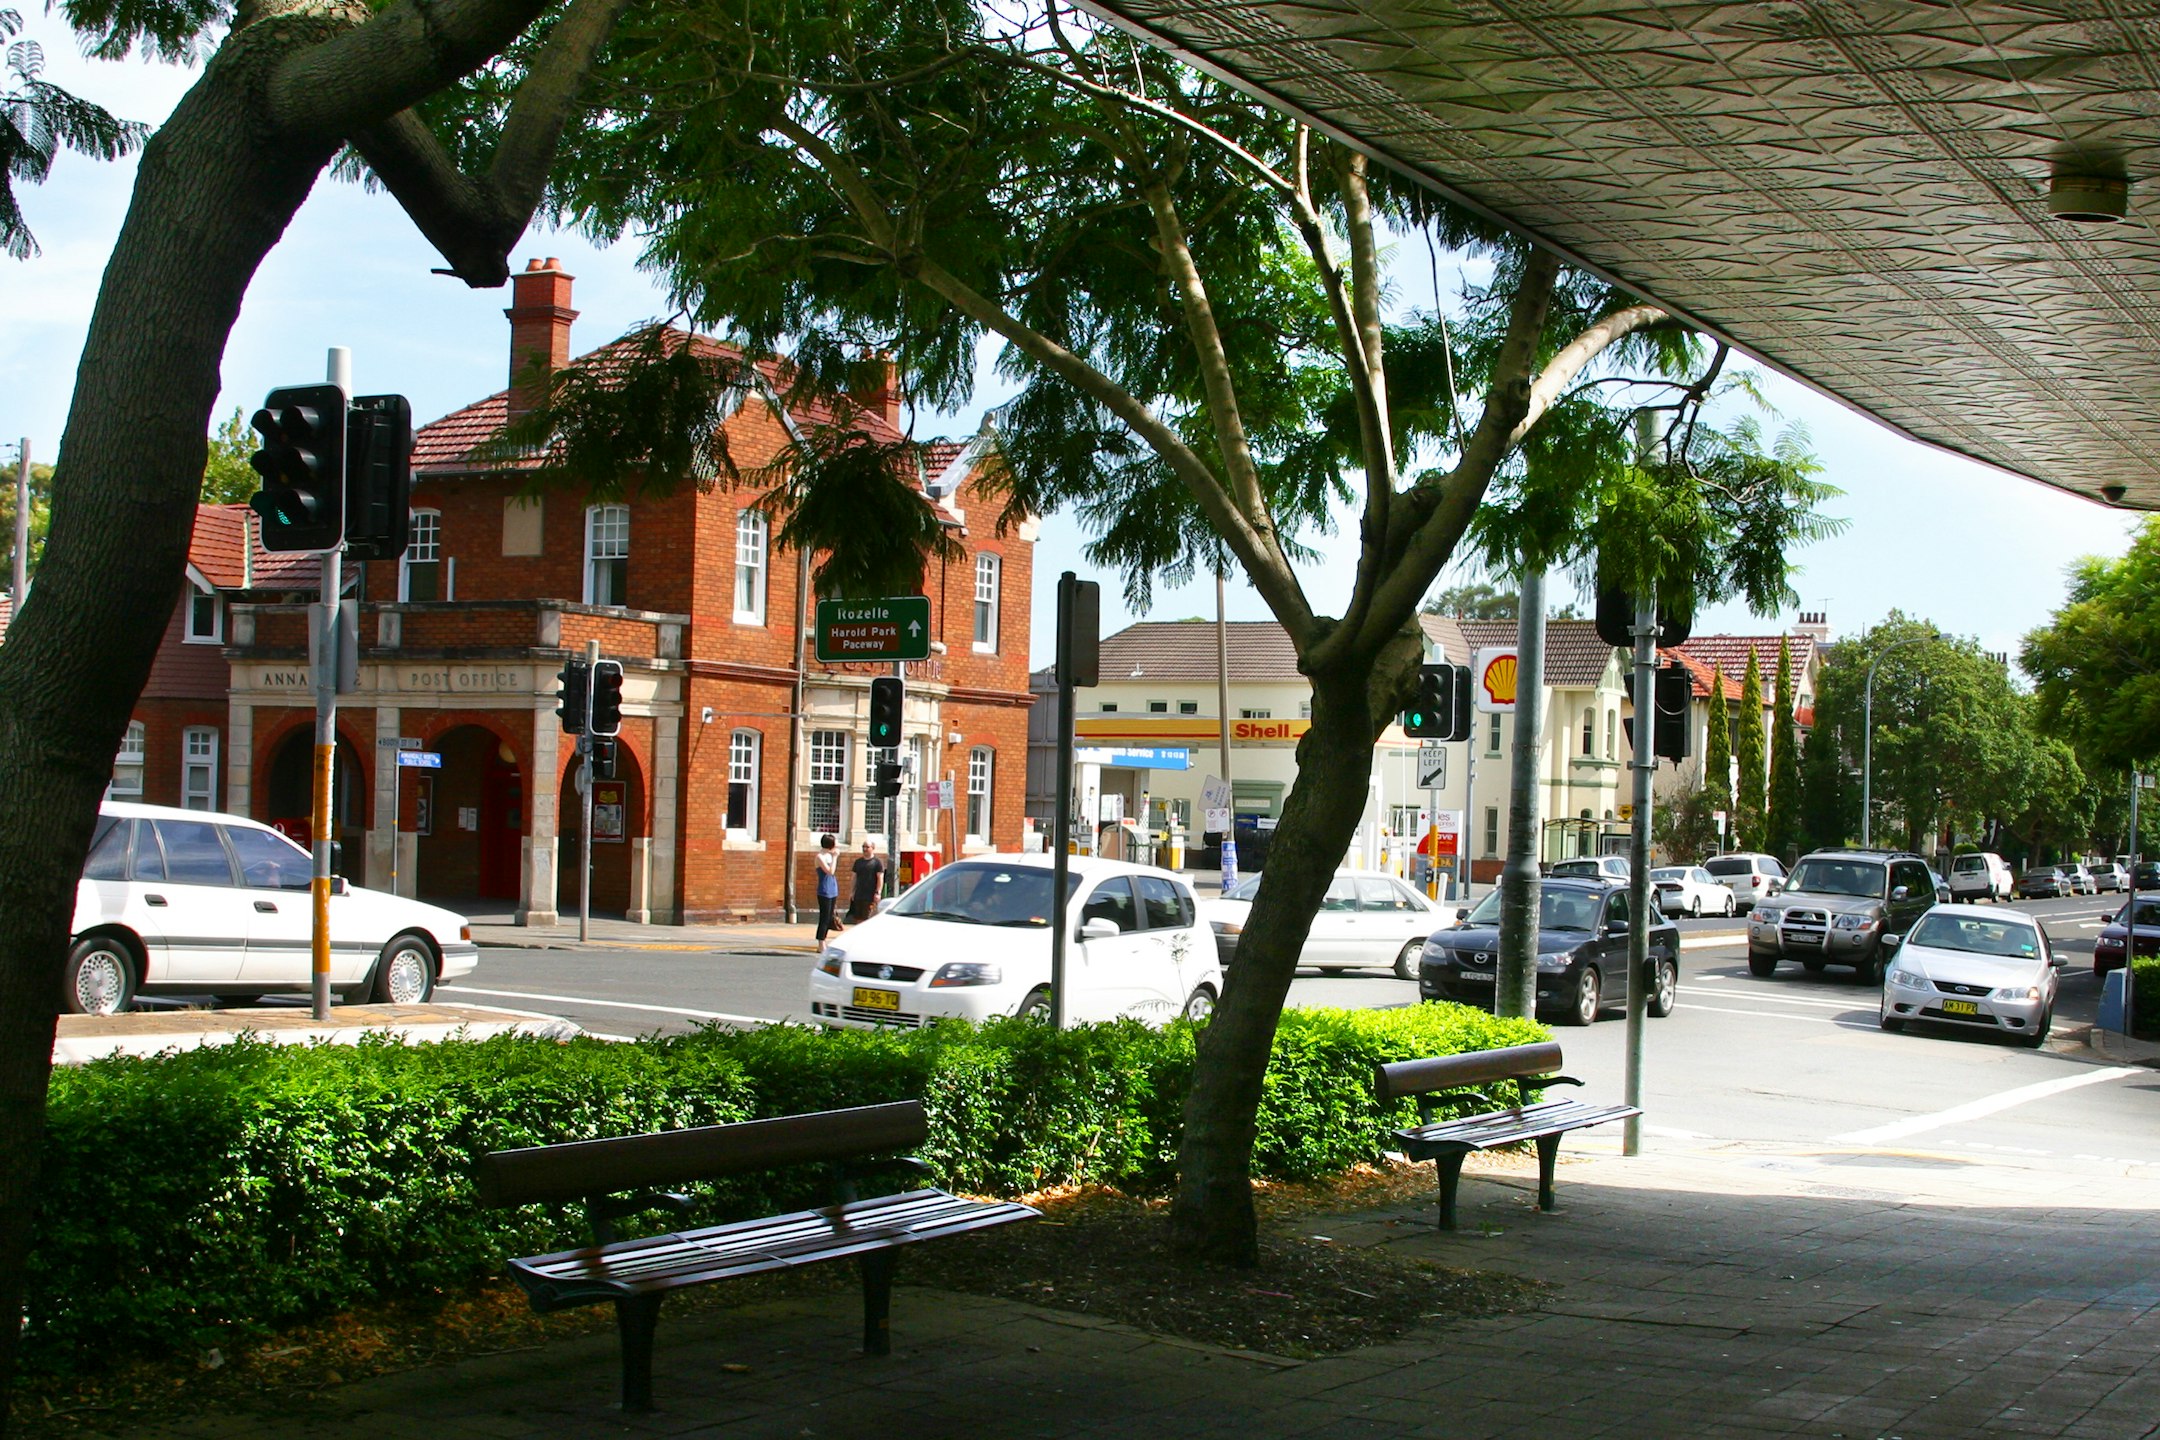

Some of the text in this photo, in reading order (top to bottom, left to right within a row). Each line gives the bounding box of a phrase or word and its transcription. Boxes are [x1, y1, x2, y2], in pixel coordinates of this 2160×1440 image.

[837, 607, 889, 620] Rozelle
[831, 626, 897, 638] Harold Park
[842, 640, 885, 650] Paceway
[264, 671, 518, 686] ANNAE POST OFFICE
[1235, 723, 1289, 738] Shell
[1423, 750, 1442, 758] KEEP
